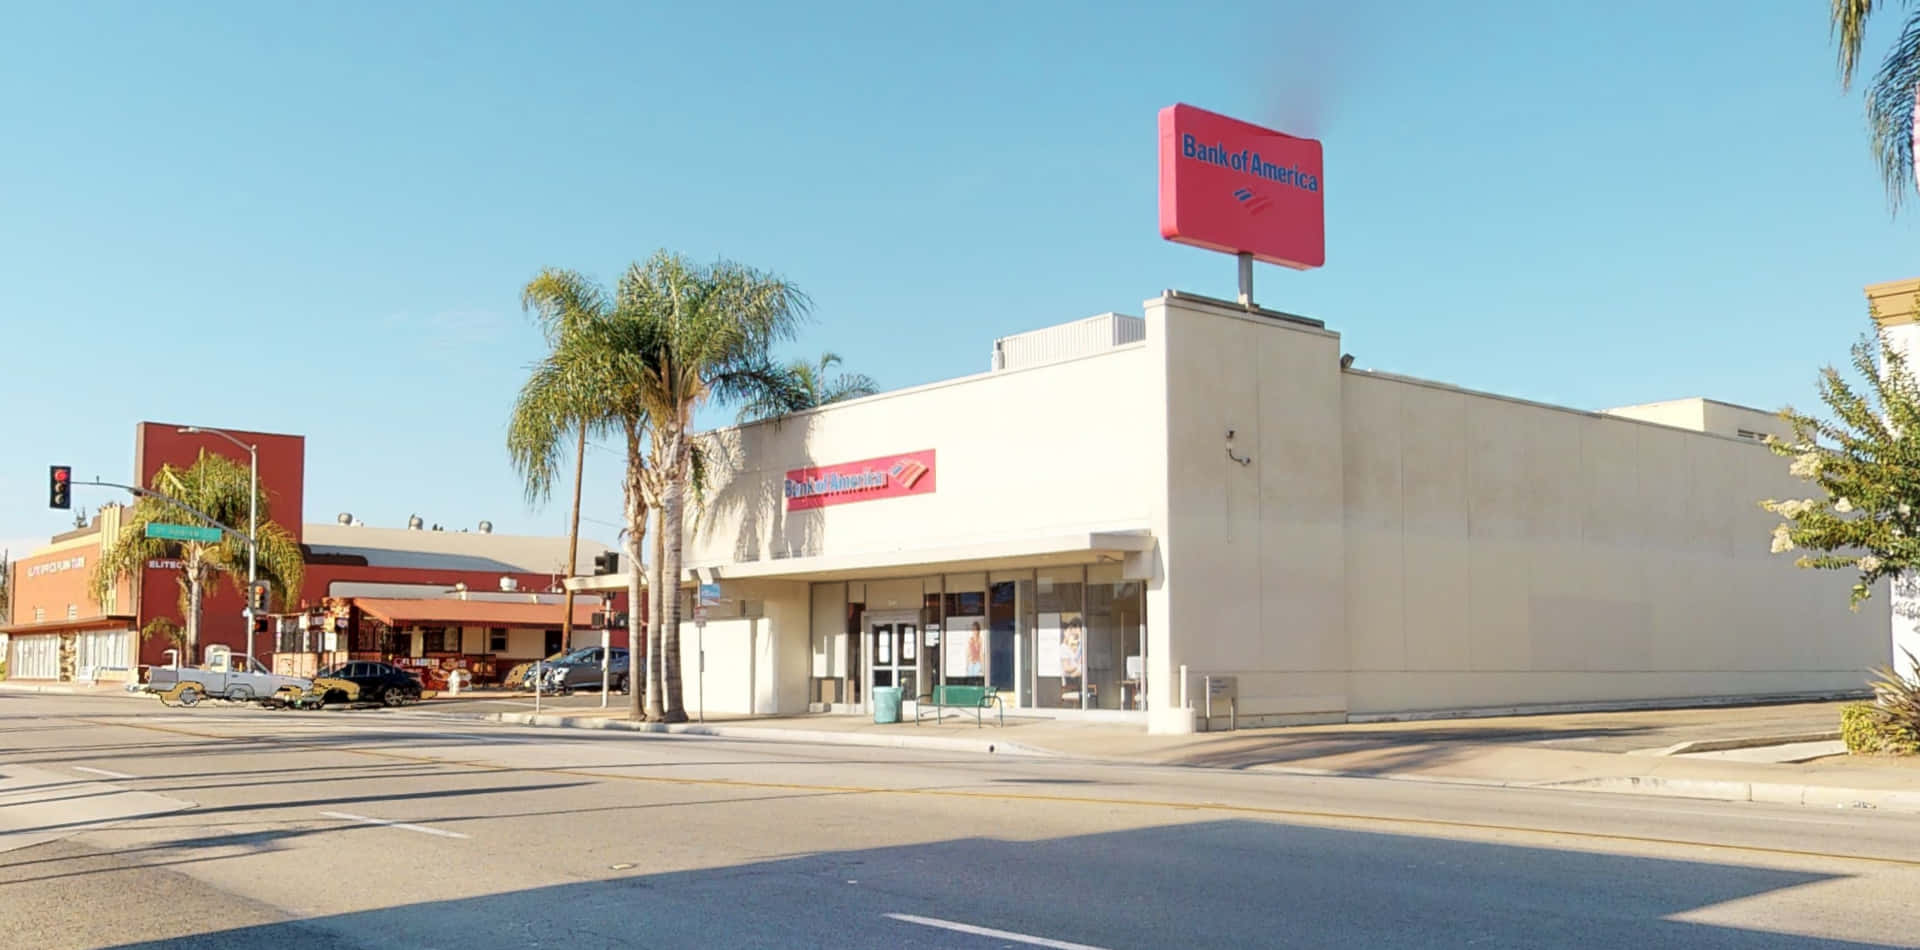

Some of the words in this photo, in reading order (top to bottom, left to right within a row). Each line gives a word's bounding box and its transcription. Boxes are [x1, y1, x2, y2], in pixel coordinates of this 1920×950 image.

[1183, 133, 1229, 167] Bank
[1231, 150, 1249, 171] of
[1251, 153, 1318, 192] America
[785, 477, 814, 498] Bank
[814, 473, 829, 493] of
[830, 471, 887, 491] America
